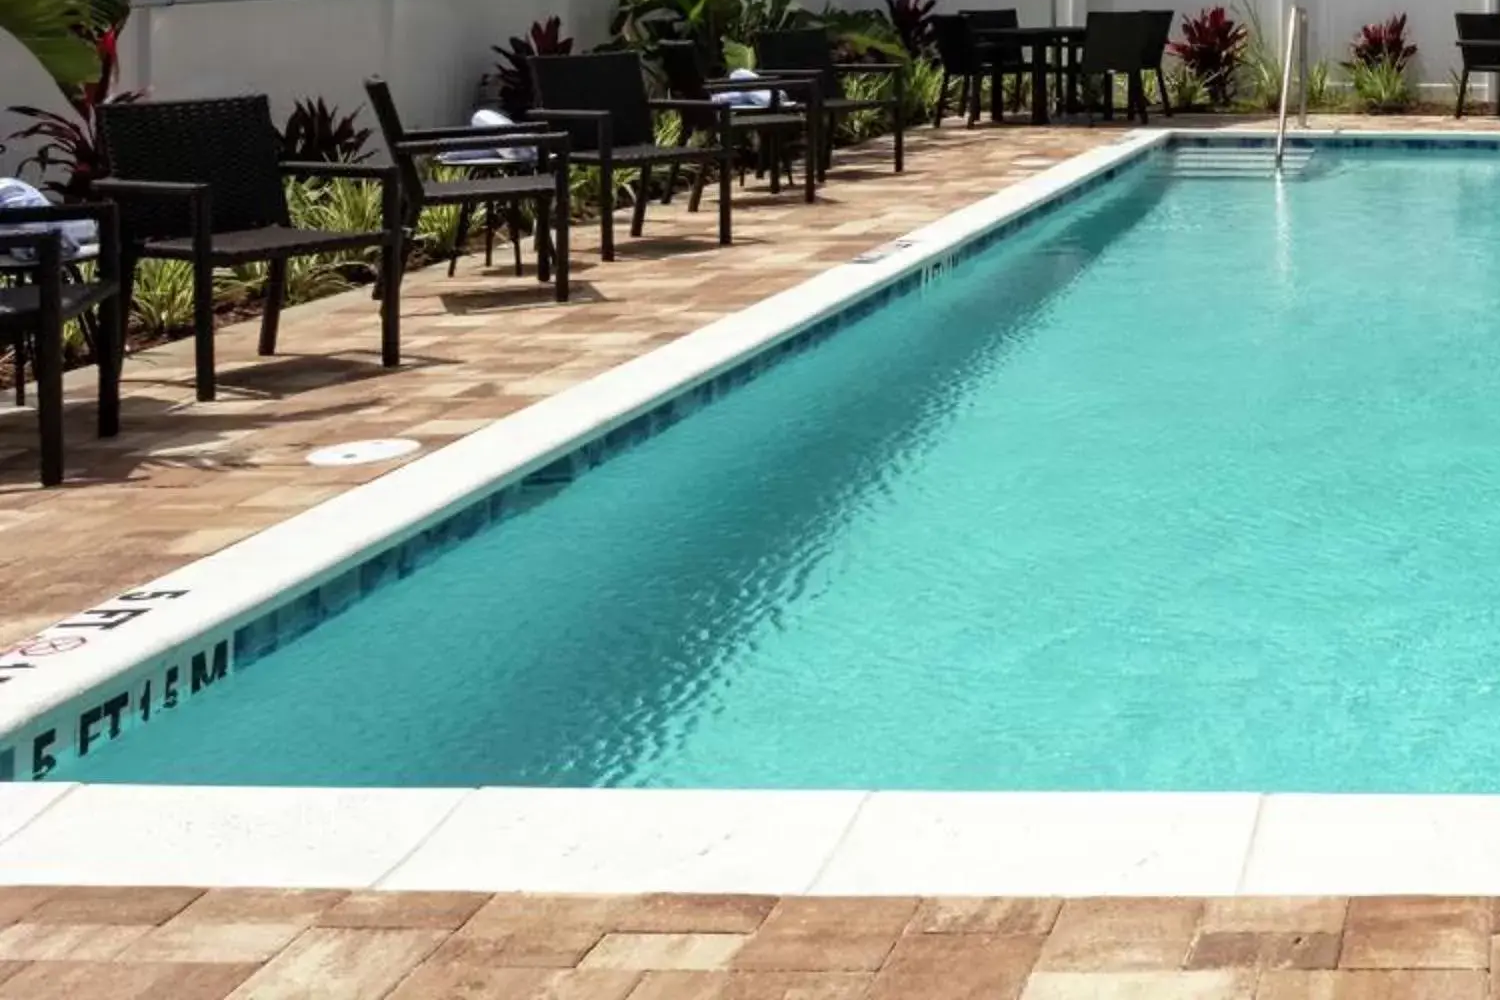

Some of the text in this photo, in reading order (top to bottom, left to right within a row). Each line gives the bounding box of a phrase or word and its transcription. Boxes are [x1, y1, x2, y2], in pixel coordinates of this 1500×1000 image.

[56, 589, 191, 630] 5 FT
[33, 728, 56, 781] 5
[78, 691, 129, 757] FT
[191, 639, 228, 694] M
